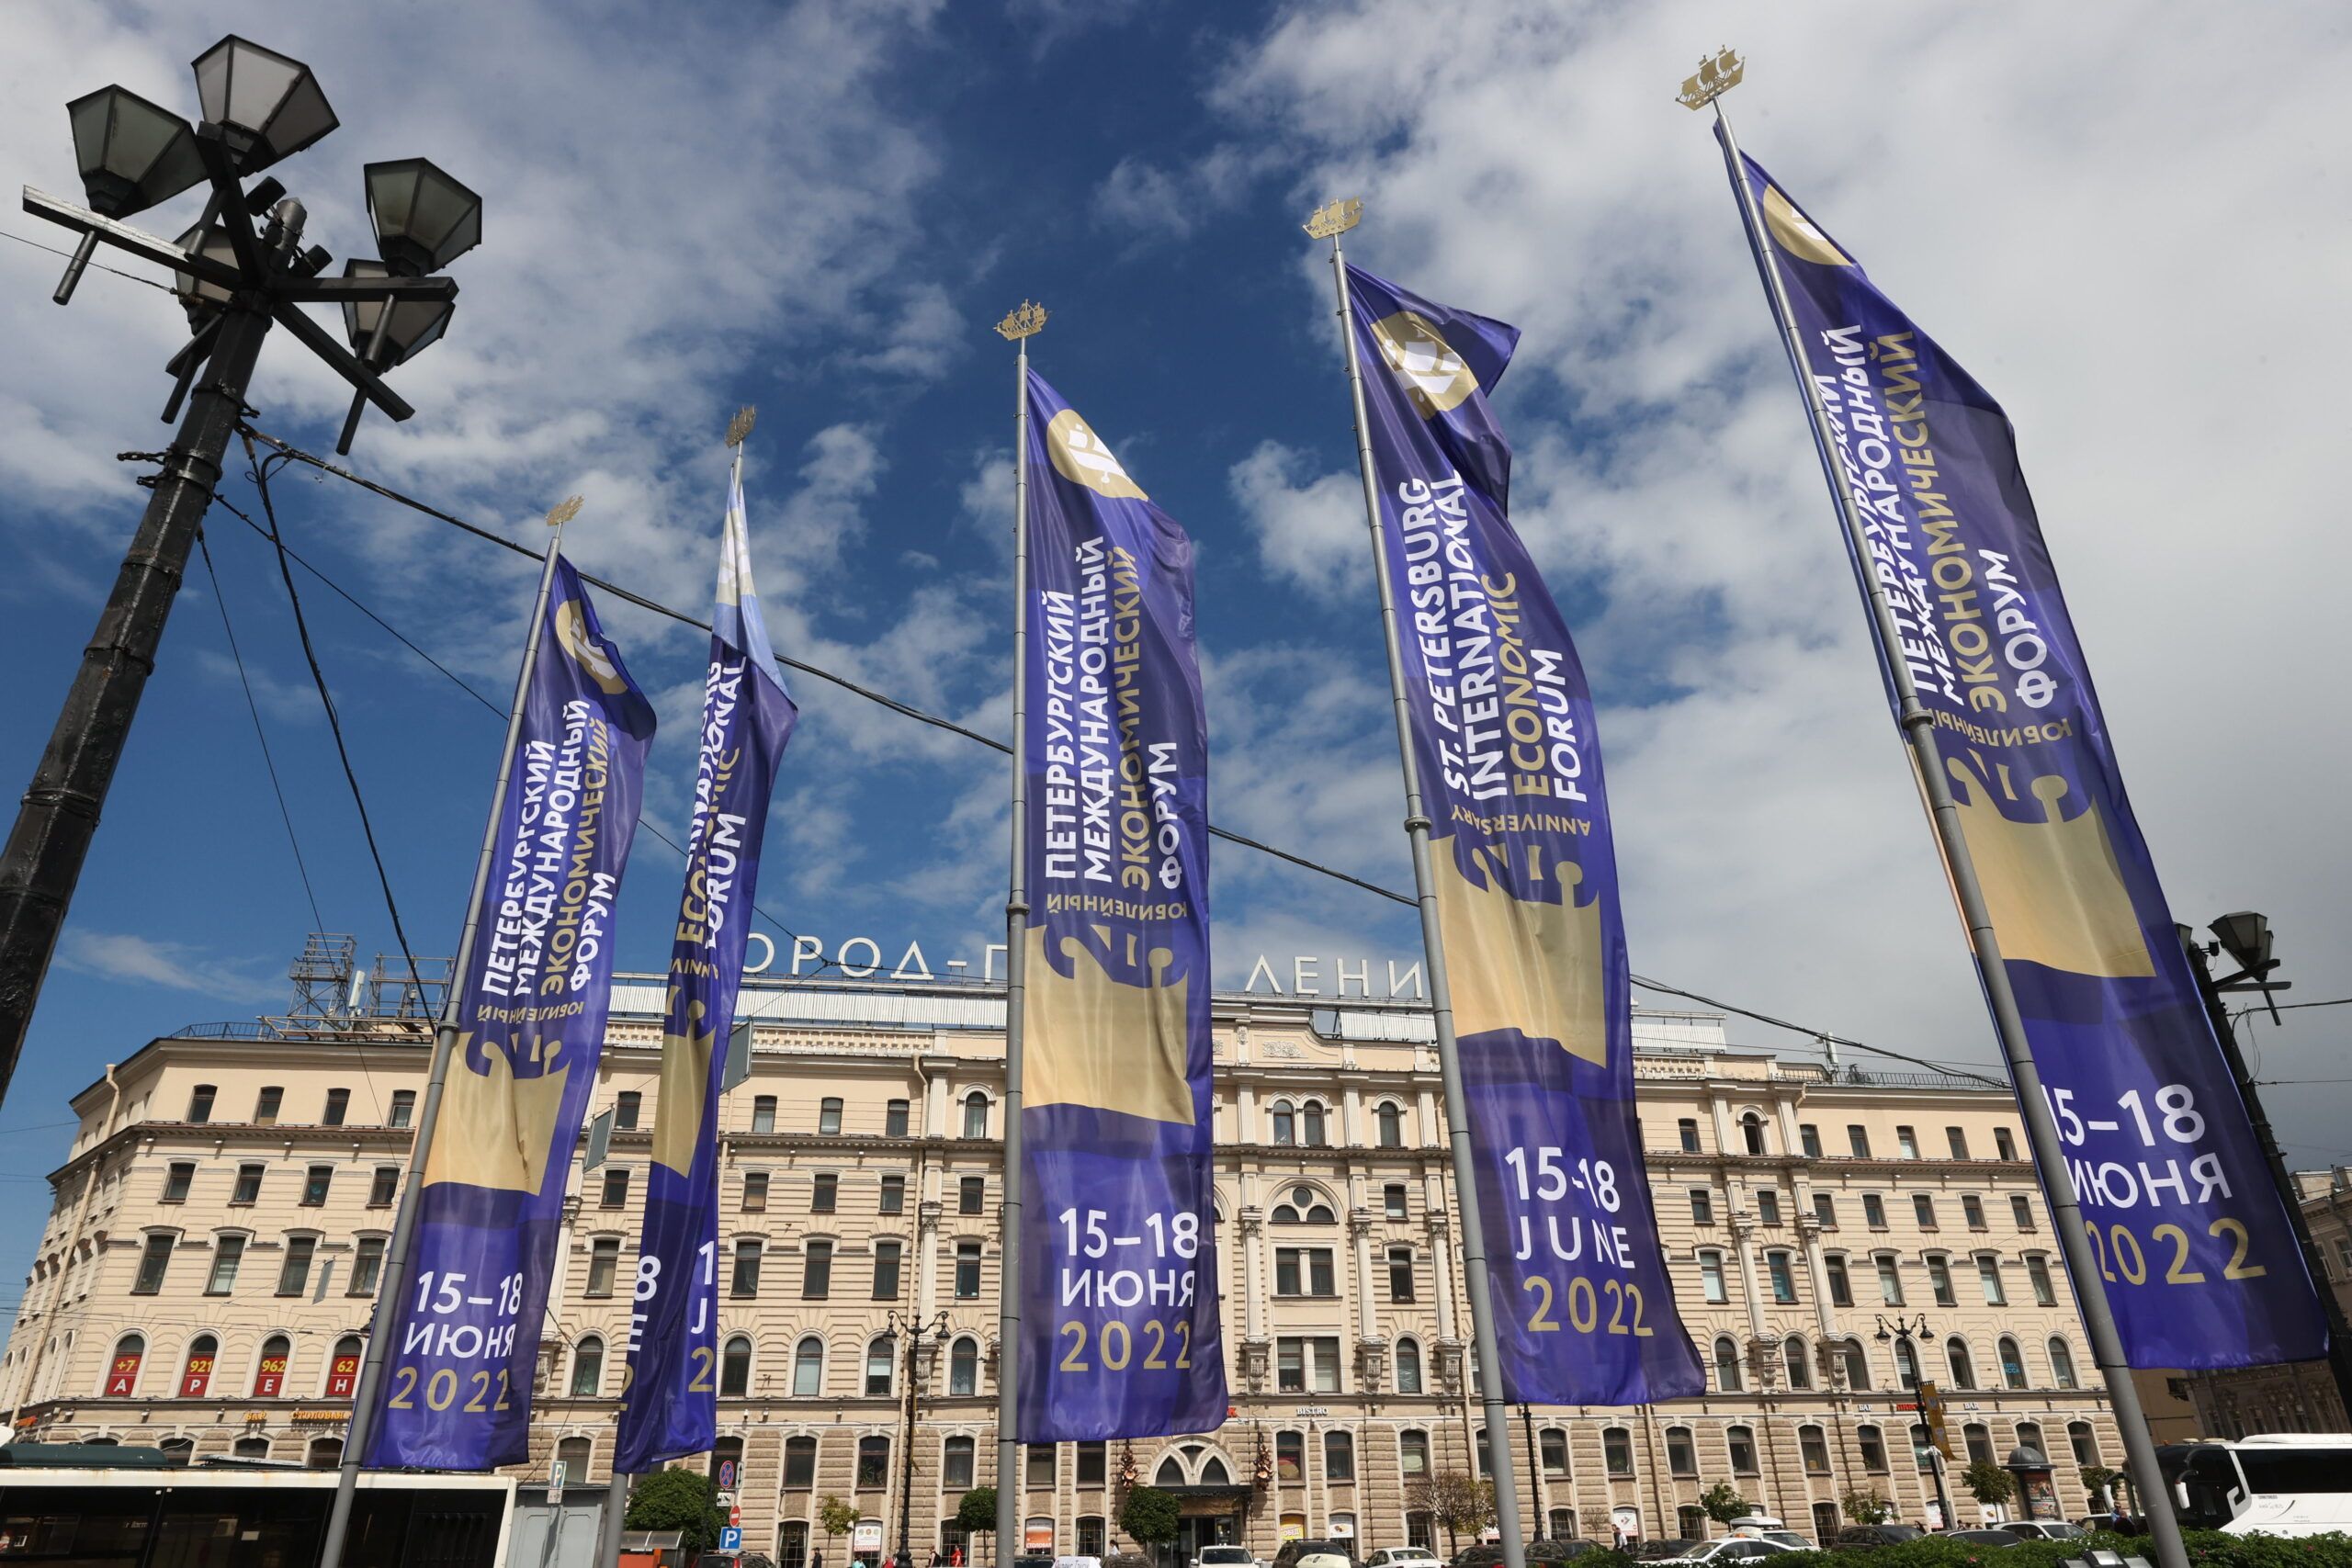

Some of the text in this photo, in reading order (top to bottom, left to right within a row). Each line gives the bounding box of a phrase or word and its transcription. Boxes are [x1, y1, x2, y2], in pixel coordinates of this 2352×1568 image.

[1870, 331, 2007, 713] ЭКОНОМИЧЕСКИЙ
[1398, 477, 1470, 796] ST. PETERSBURG
[1430, 468, 1508, 800] INTERNATIONAL
[1481, 571, 1550, 796] ECONOMIC
[1978, 548, 2058, 709] ФОРУМ
[1042, 590, 1076, 879] ПЕТЕРБУРГСКИЙ
[1075, 536, 1114, 883] МЕЖДУНАРОДНЫЙ
[1107, 546, 1151, 891] ЭКОНОМИЧЕСКИЙ
[1531, 649, 1588, 803] FORUM
[482, 740, 556, 997] ПЕТЕРБУРГСКИЙ
[514, 700, 591, 997] МЕЖДУНАРОДНЫЙ
[541, 717, 609, 997] ЭКОНОМИЧЕСКИЙ
[1148, 742, 1182, 890] ФОРУМ
[1451, 805, 1590, 836] ANNIVERSARY
[571, 873, 616, 991] ФОРУМ
[1047, 894, 1187, 920] ЮБИЛЕЙНЫЙ
[477, 1001, 584, 1023] ЮБИЛЕЙНЫЙ
[2062, 1152, 2233, 1209] ИЮНЯ
[1062, 1269, 1195, 1307] ИЮНЯ
[1516, 1216, 1635, 1269] JUNE
[2086, 1217, 2267, 1285] 2022
[402, 1323, 516, 1359] ИЮНЯ
[1059, 1319, 1190, 1371] 2022
[1522, 1275, 1654, 1337] 2022
[117, 1359, 355, 1372] +7 921 962 62
[388, 1367, 509, 1413] 2022
[1296, 1406, 1329, 1416] BISTRO
